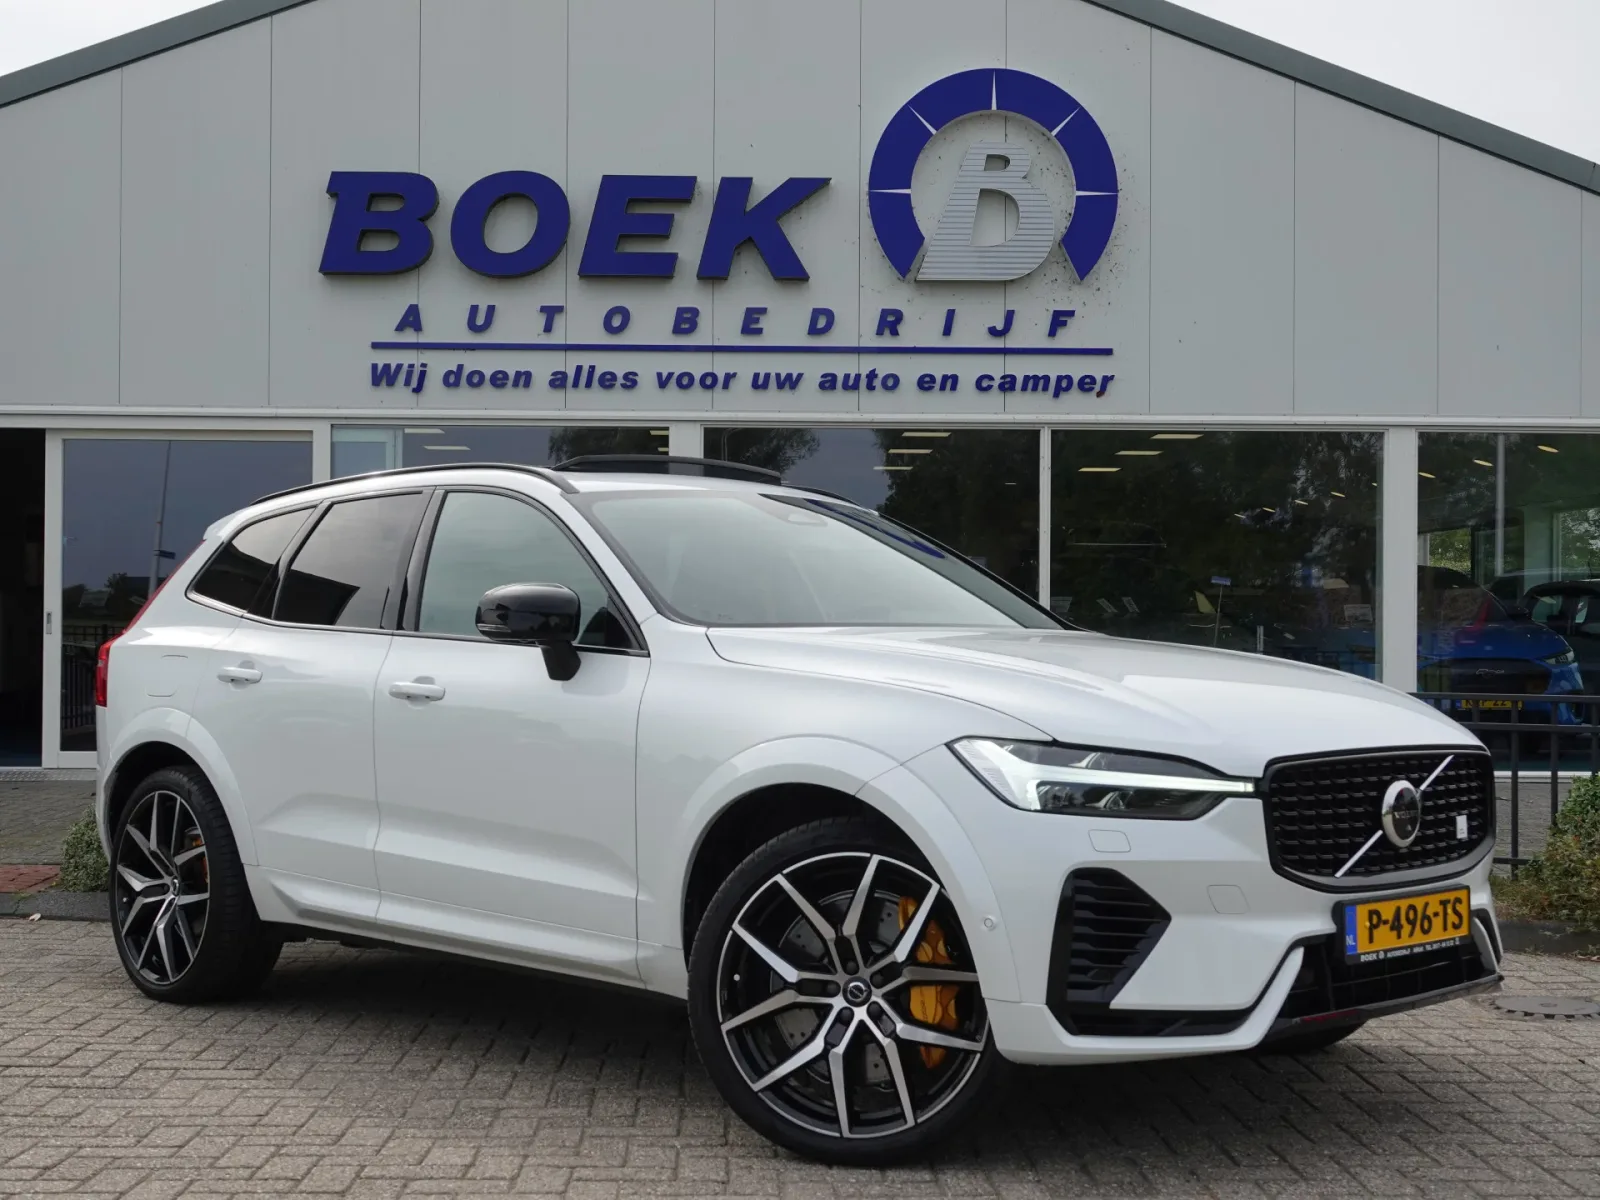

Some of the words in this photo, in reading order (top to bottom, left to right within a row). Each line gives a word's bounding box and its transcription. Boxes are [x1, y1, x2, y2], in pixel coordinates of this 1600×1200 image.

[319, 169, 831, 279] BOEK
[916, 141, 1055, 281] B
[395, 303, 1076, 338] AUTOBEDRIJF
[370, 362, 428, 393] Wij
[442, 363, 533, 389] doen
[548, 364, 639, 390] alles
[655, 371, 737, 391] voor
[750, 371, 804, 392] uw
[818, 367, 901, 393] auto
[916, 372, 960, 393] en
[974, 373, 1116, 398] camper
[1367, 896, 1464, 944] P-496-TS
[1345, 934, 1356, 946] NL
[1360, 952, 1378, 962] BOEK
